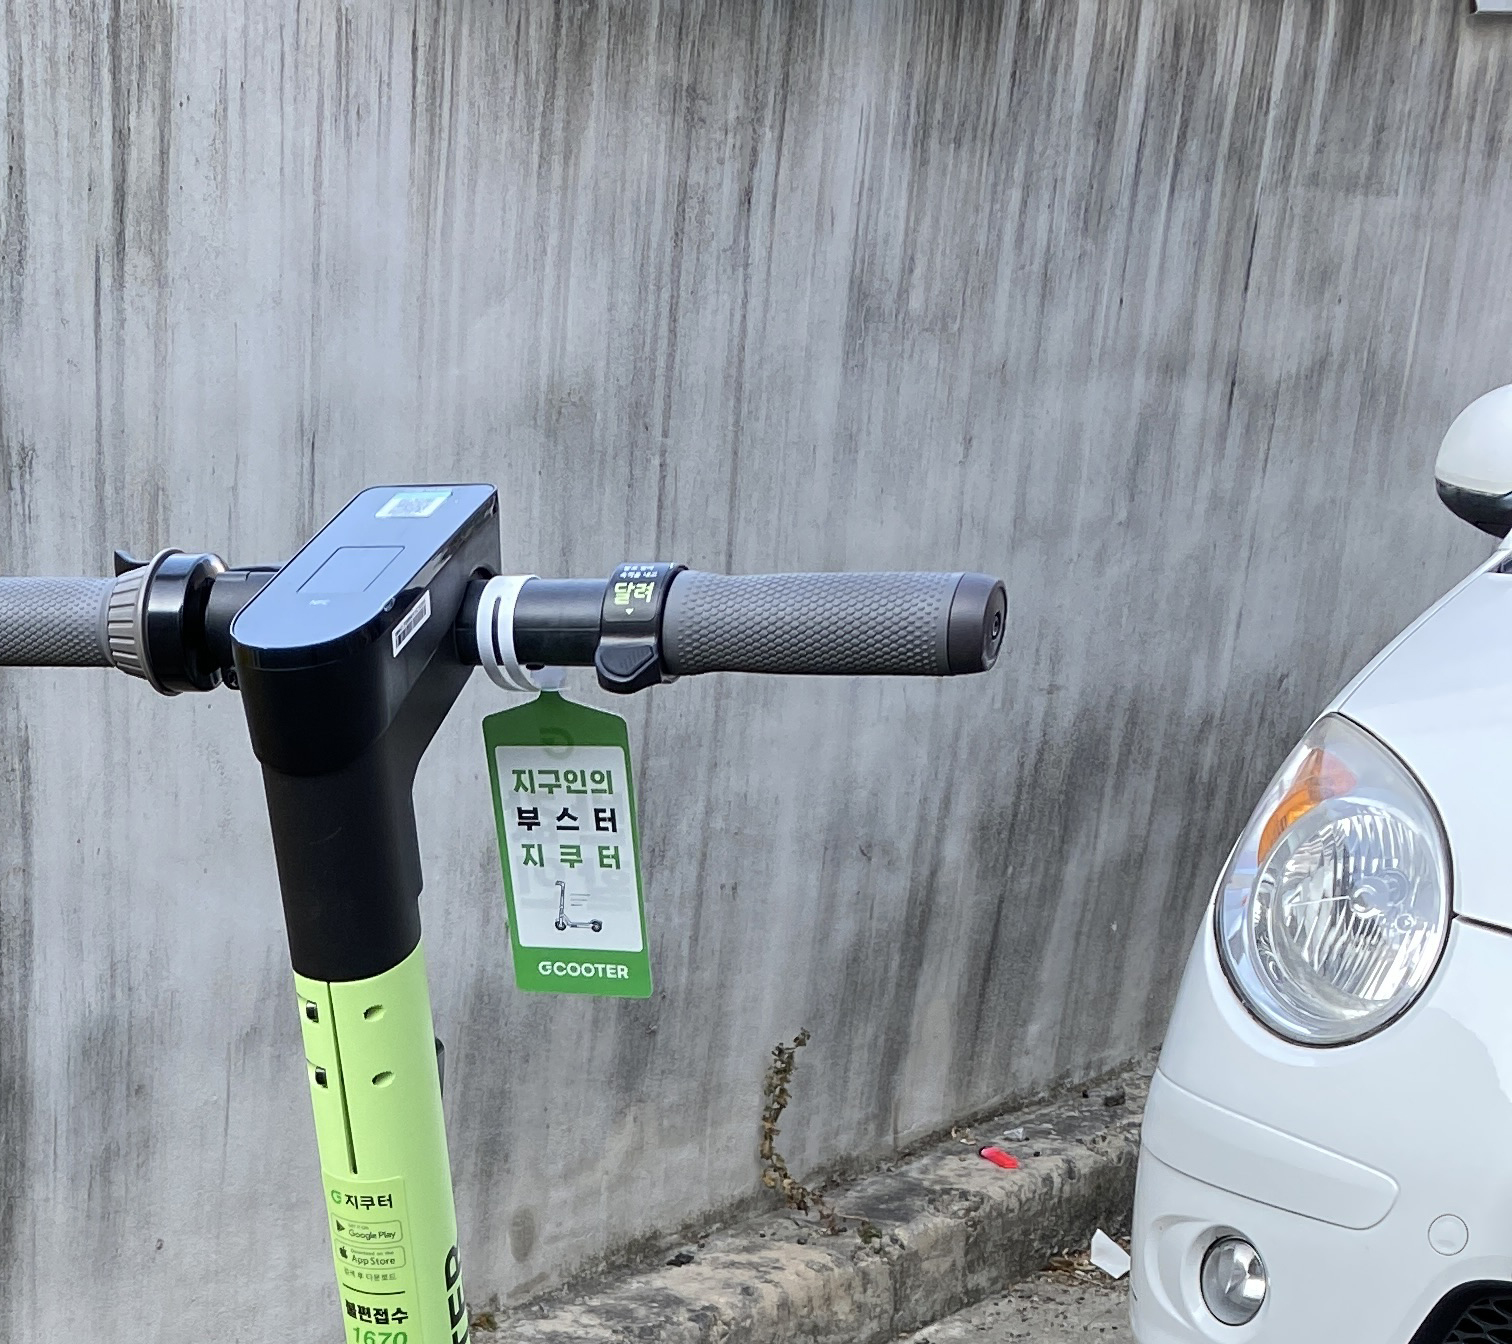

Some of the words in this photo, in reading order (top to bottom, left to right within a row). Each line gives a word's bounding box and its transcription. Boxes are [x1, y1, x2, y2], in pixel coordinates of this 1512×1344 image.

[614, 581, 655, 605] 달려
[511, 769, 614, 795] 지구인의
[537, 961, 629, 980] GCOOTER
[344, 1193, 393, 1211] 지쿠터
[348, 1229, 377, 1241] Google
[378, 1231, 396, 1240] Play
[352, 1254, 369, 1266] App
[370, 1257, 396, 1266] Store
[345, 1299, 409, 1326] 불편접수
